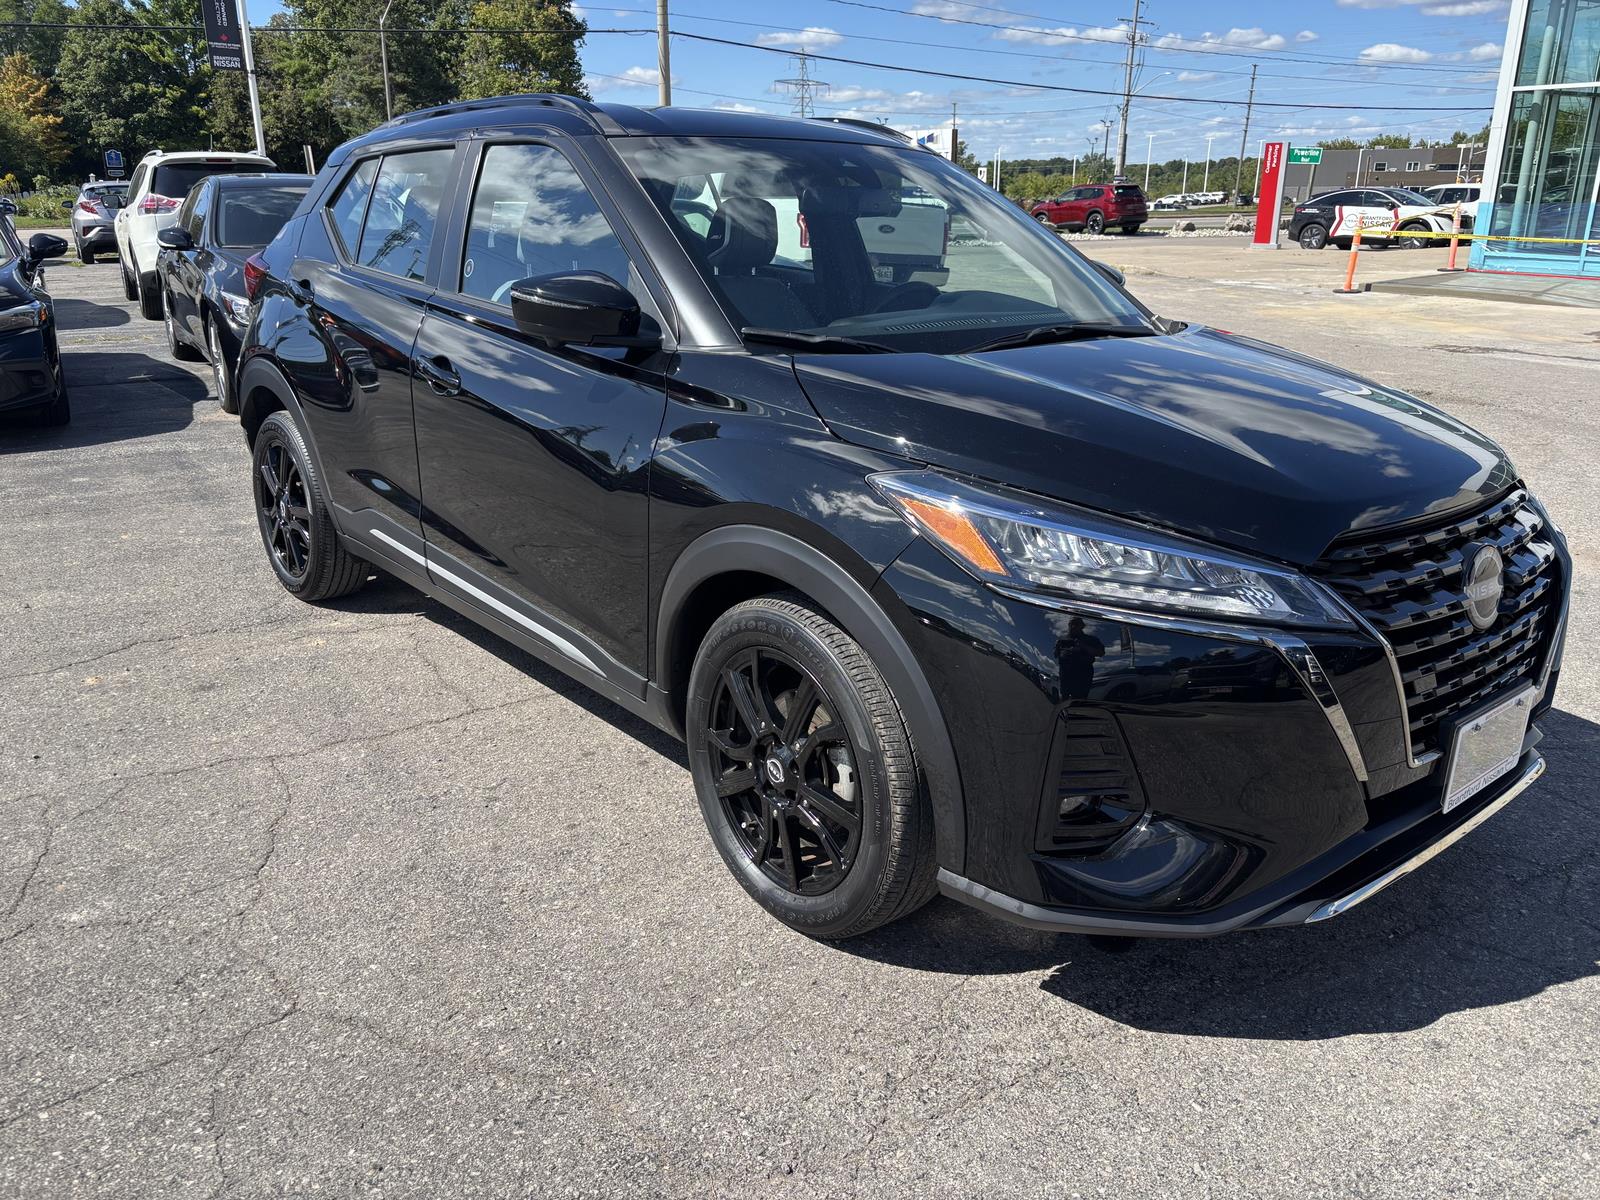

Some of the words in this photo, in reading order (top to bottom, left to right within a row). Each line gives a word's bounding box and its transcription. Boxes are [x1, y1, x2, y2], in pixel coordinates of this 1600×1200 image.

[213, 60, 241, 68] NISSAN
[1265, 145, 1273, 174] Customer
[1272, 144, 1280, 168] Parking
[1447, 782, 1481, 810] Brantford
[1481, 767, 1504, 788] Nissan
